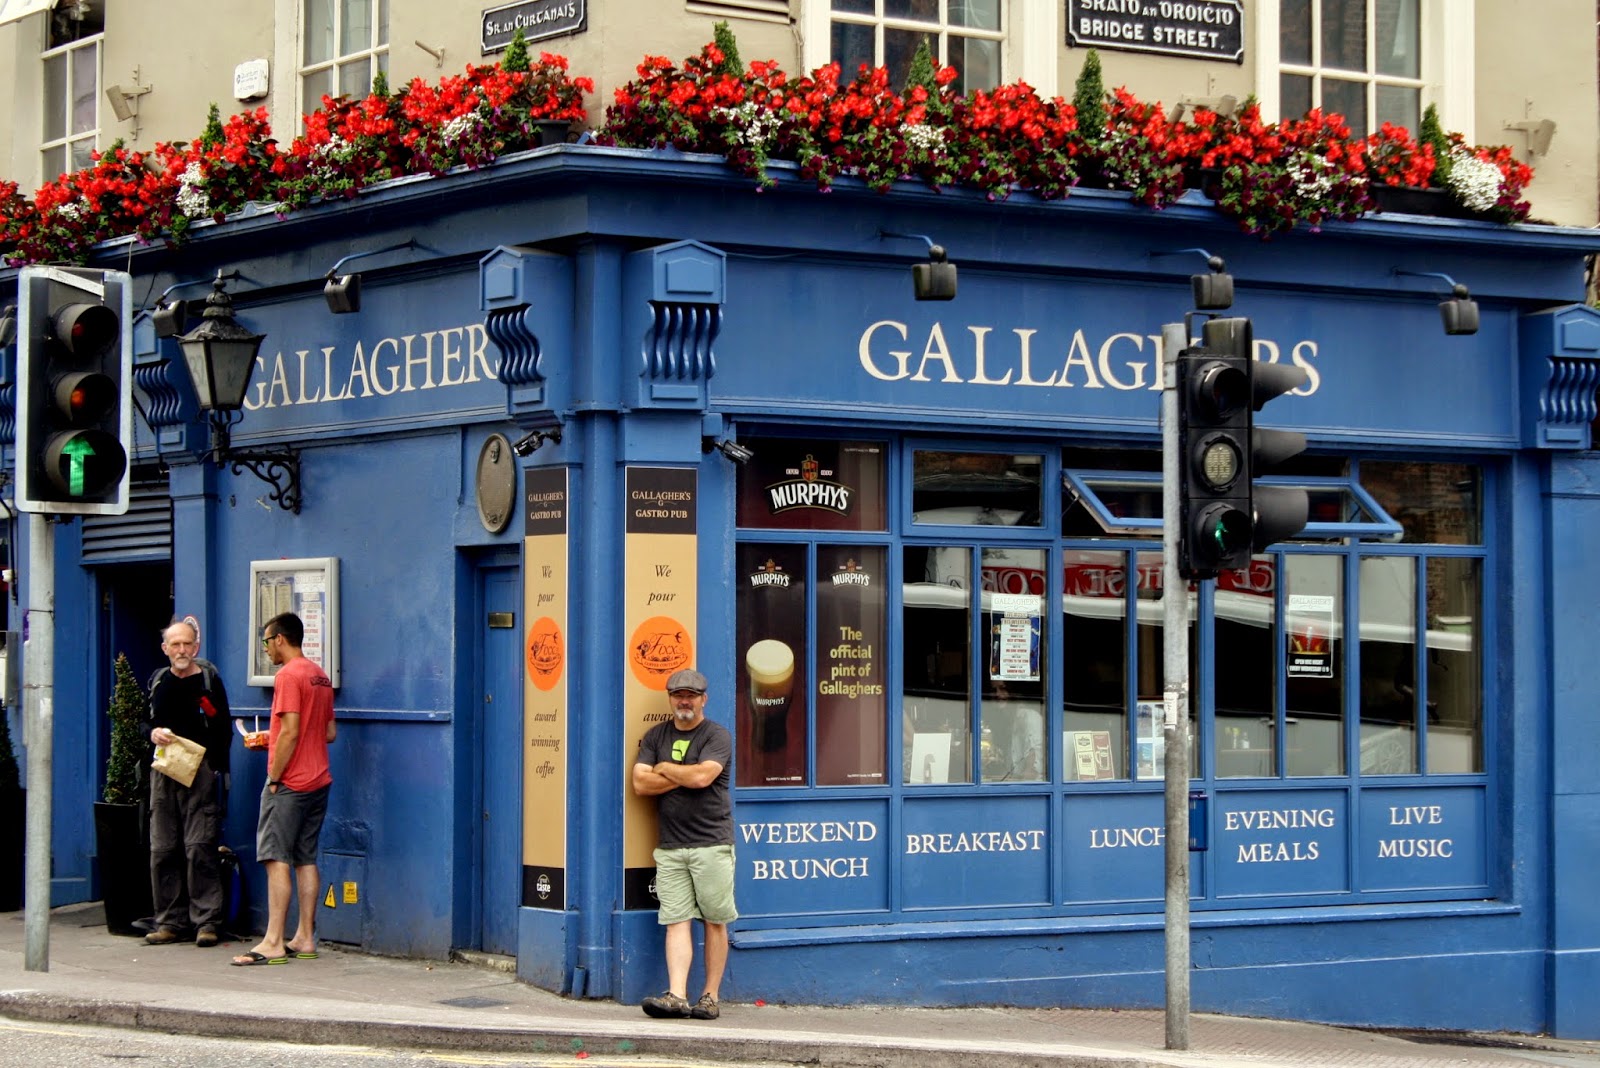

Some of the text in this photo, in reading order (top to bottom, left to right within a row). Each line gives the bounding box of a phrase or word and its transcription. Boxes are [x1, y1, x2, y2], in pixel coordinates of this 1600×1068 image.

[1079, 18, 1146, 41] BRIDGE
[242, 322, 499, 411] GALLAGHER
[858, 319, 1321, 397] GALLAGRS
[631, 490, 691, 501] GALLAGHER'S
[530, 510, 562, 520] GASTRO PUB
[635, 509, 688, 519] GASTRO PUB
[541, 565, 553, 579] We
[655, 564, 672, 578] We
[537, 592, 555, 607] pour
[647, 592, 676, 605] pour
[840, 626, 862, 641] The
[829, 644, 872, 659] official
[831, 663, 872, 680] pint of
[819, 680, 882, 698] Gallaghers
[534, 709, 557, 722] award
[643, 711, 675, 722] awar
[531, 735, 560, 751] winning
[535, 761, 555, 778] coffee
[1224, 808, 1335, 831] EVENING
[1389, 806, 1442, 826] LIVE
[739, 821, 877, 844] WEEKEND
[905, 830, 1045, 855] BREAKFAST
[1377, 838, 1453, 858] MUSIC
[1236, 841, 1320, 863] MEALS
[752, 857, 869, 880] BRUNCH
